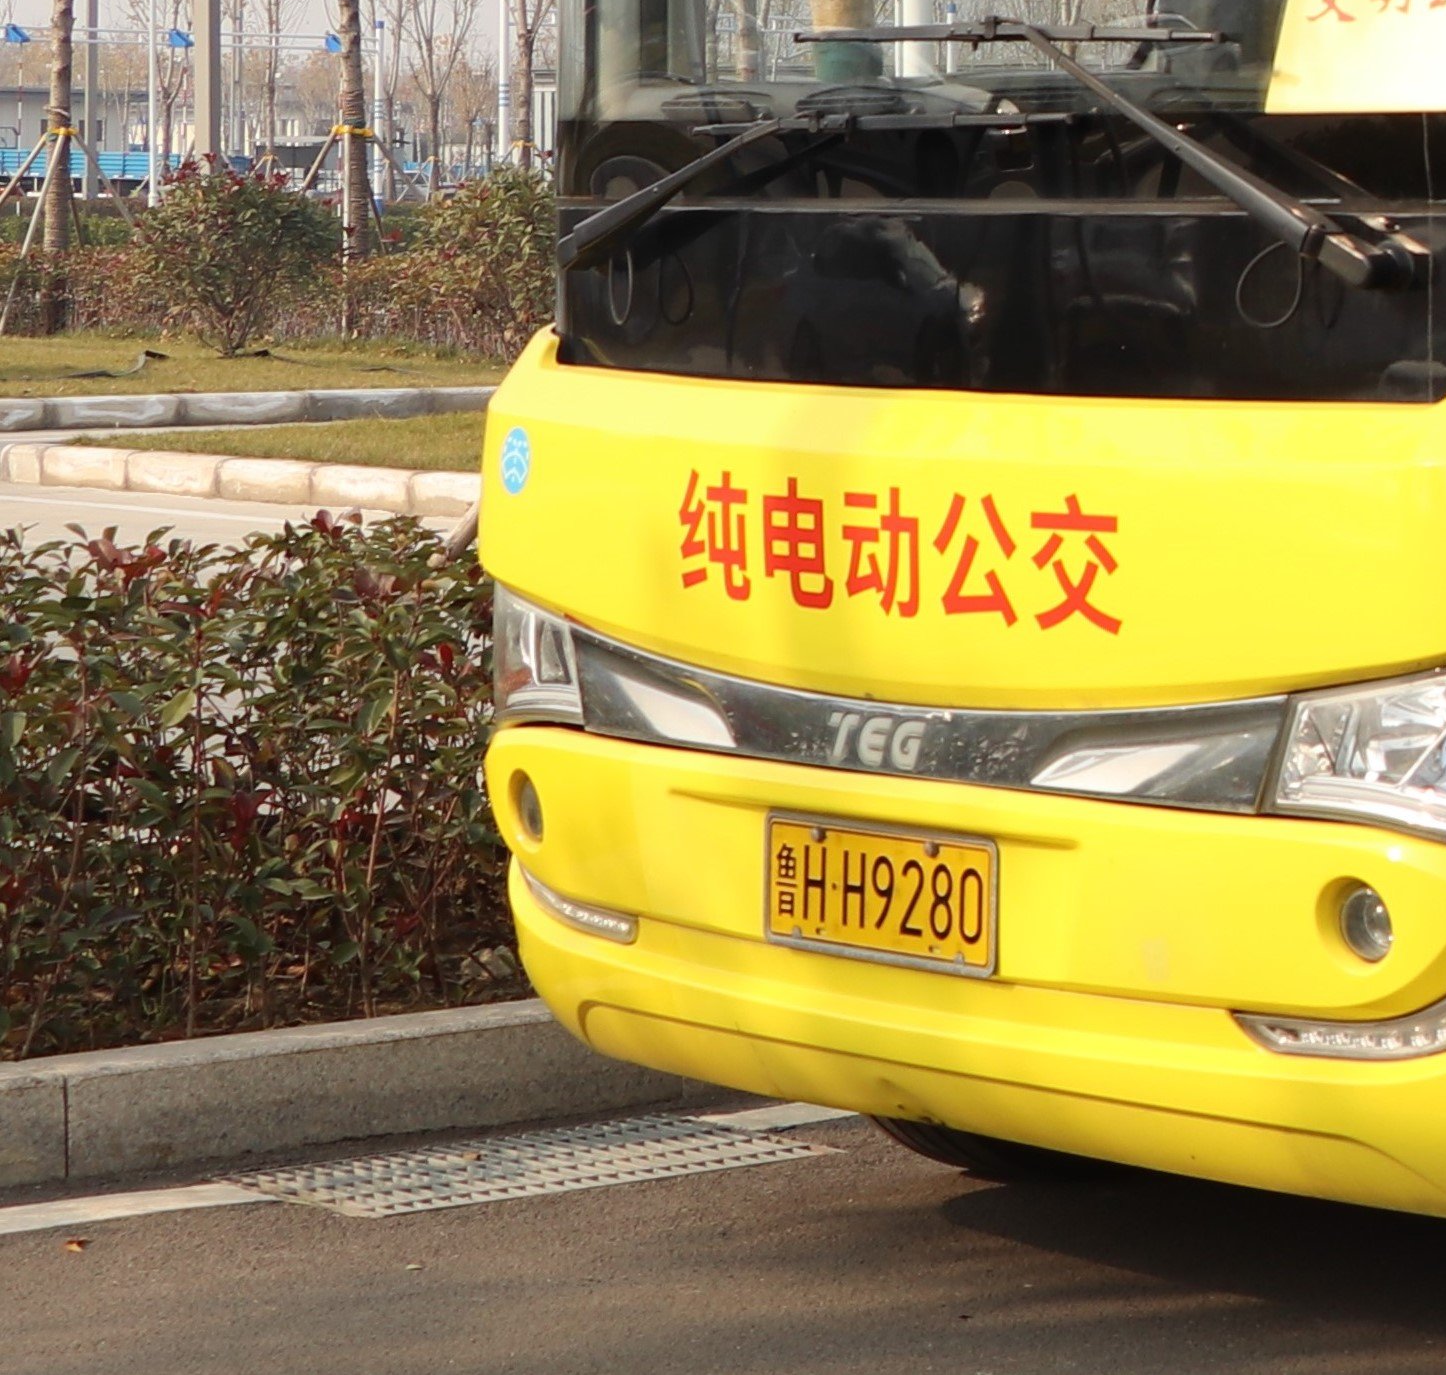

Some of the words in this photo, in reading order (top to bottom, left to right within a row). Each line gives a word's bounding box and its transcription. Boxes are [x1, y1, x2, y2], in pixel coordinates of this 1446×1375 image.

[678, 469, 1123, 635] 纯电动公交
[827, 711, 928, 772] TEG
